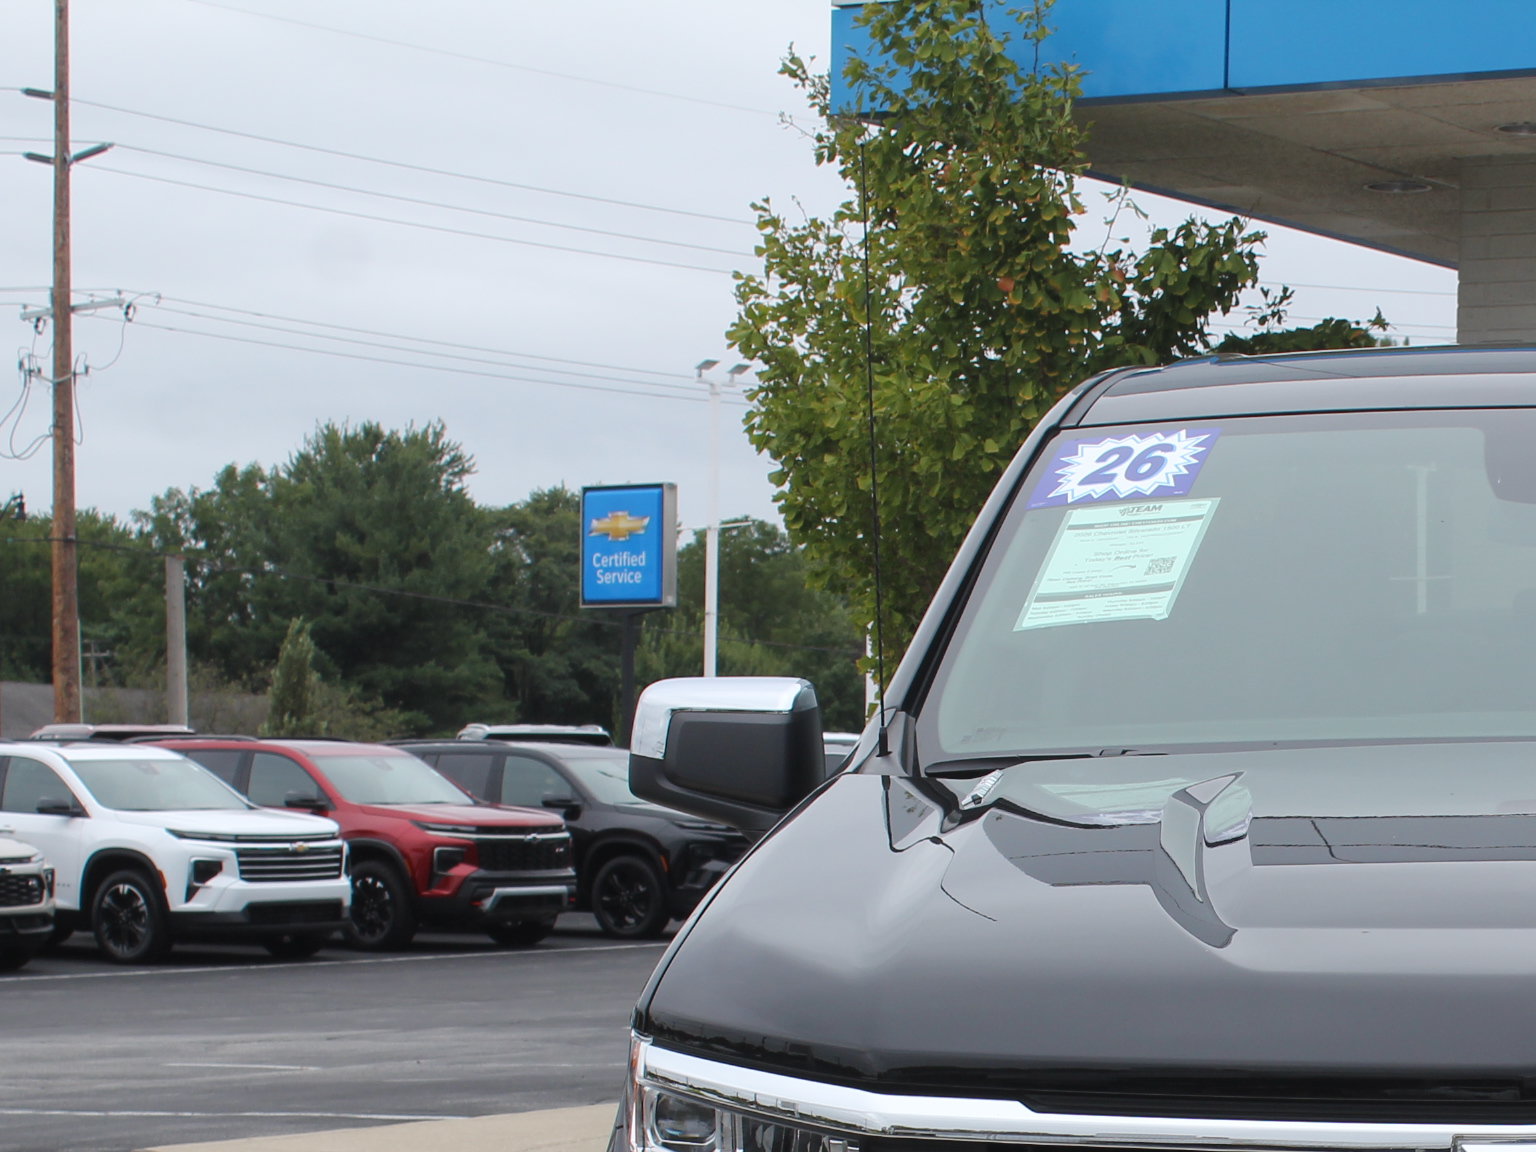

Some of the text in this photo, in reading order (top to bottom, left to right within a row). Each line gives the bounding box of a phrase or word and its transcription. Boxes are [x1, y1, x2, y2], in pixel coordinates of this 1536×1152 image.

[1077, 442, 1176, 486] 26
[1129, 504, 1163, 513] TEAM
[592, 551, 646, 568] Certified
[596, 569, 642, 585] Service
